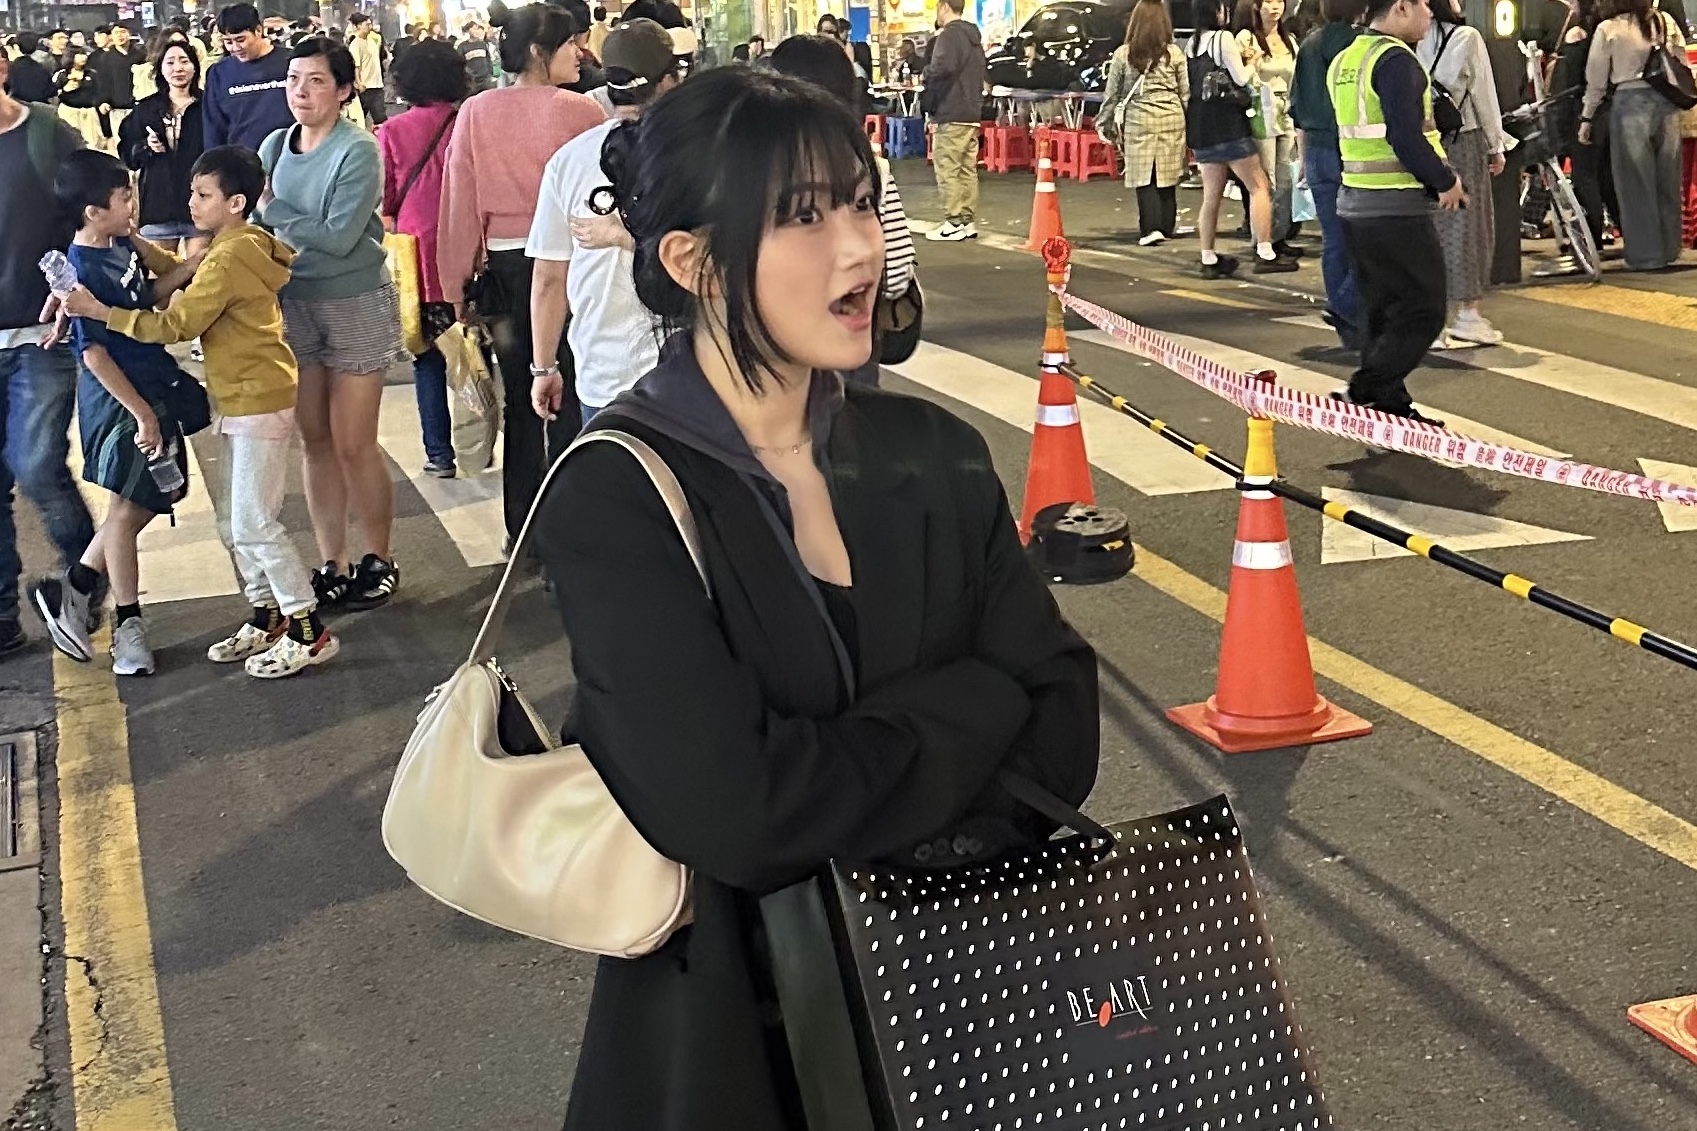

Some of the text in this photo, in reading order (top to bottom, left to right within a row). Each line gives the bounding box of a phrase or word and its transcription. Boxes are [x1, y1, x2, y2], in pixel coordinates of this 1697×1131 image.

[1264, 397, 1294, 419] DANGER
[1403, 430, 1442, 453] DANGER
[1446, 439, 1467, 460] 위험
[1502, 451, 1547, 477] 안전제일
